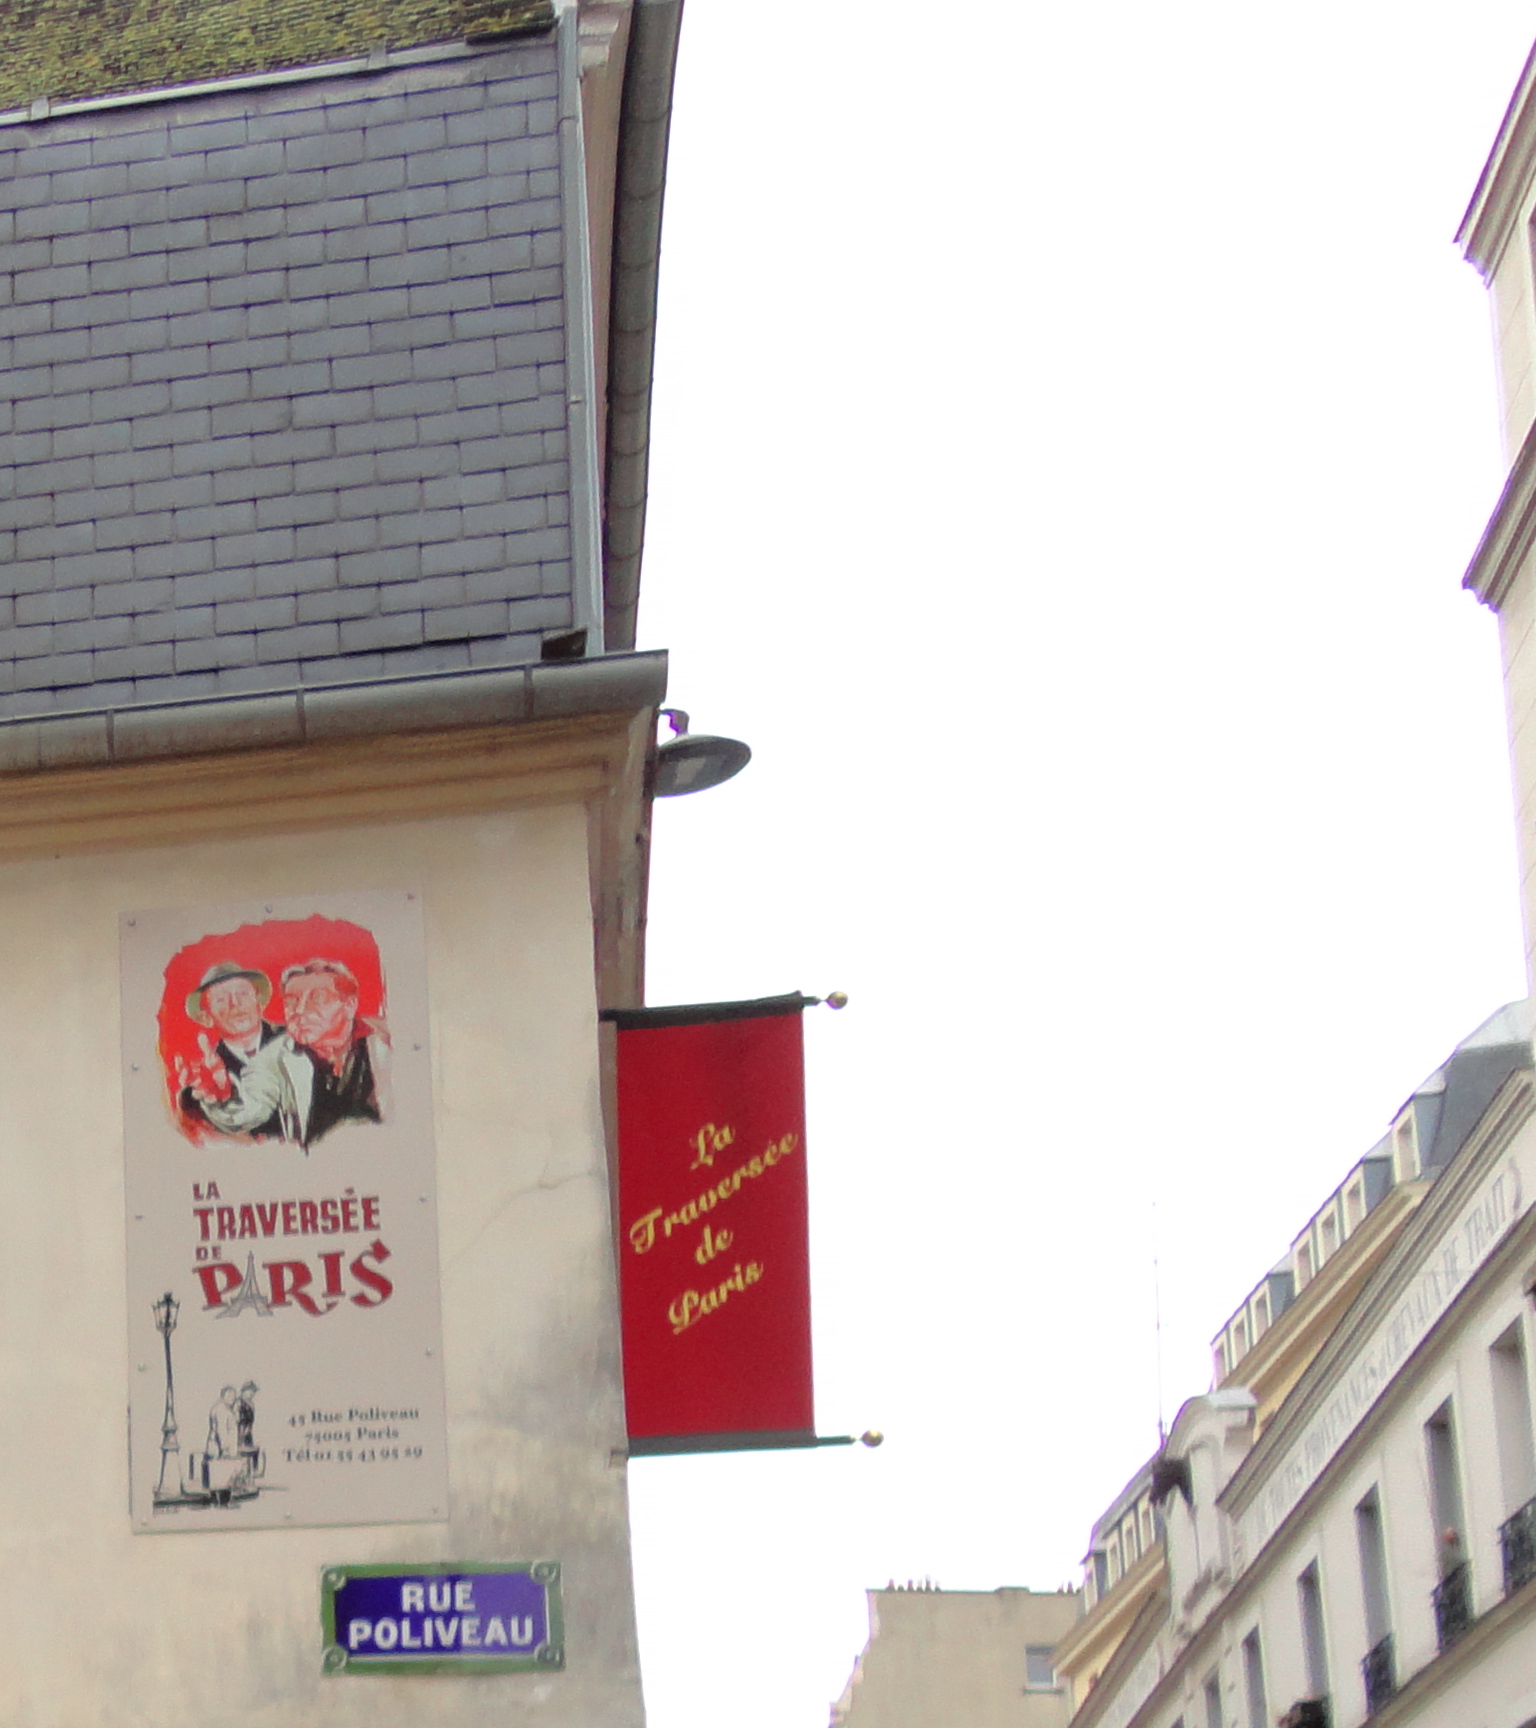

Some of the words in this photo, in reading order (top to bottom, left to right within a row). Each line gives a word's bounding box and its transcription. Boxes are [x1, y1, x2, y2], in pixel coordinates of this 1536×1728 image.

[689, 1122, 736, 1170] La
[192, 1181, 220, 1200] LA
[629, 1132, 799, 1254] Traversée
[193, 1186, 381, 1241] TRAVERSÉE
[195, 1245, 222, 1261] DE
[695, 1224, 734, 1265] de
[192, 1238, 394, 1319] PARIS
[668, 1261, 764, 1335] Paris
[311, 1409, 343, 1423] Rue
[348, 1407, 419, 1421] Poliveau
[305, 1430, 351, 1443] 75005
[357, 1426, 399, 1440] Paris
[401, 1580, 476, 1613] RUE
[348, 1615, 534, 1650] POLIVEAU
